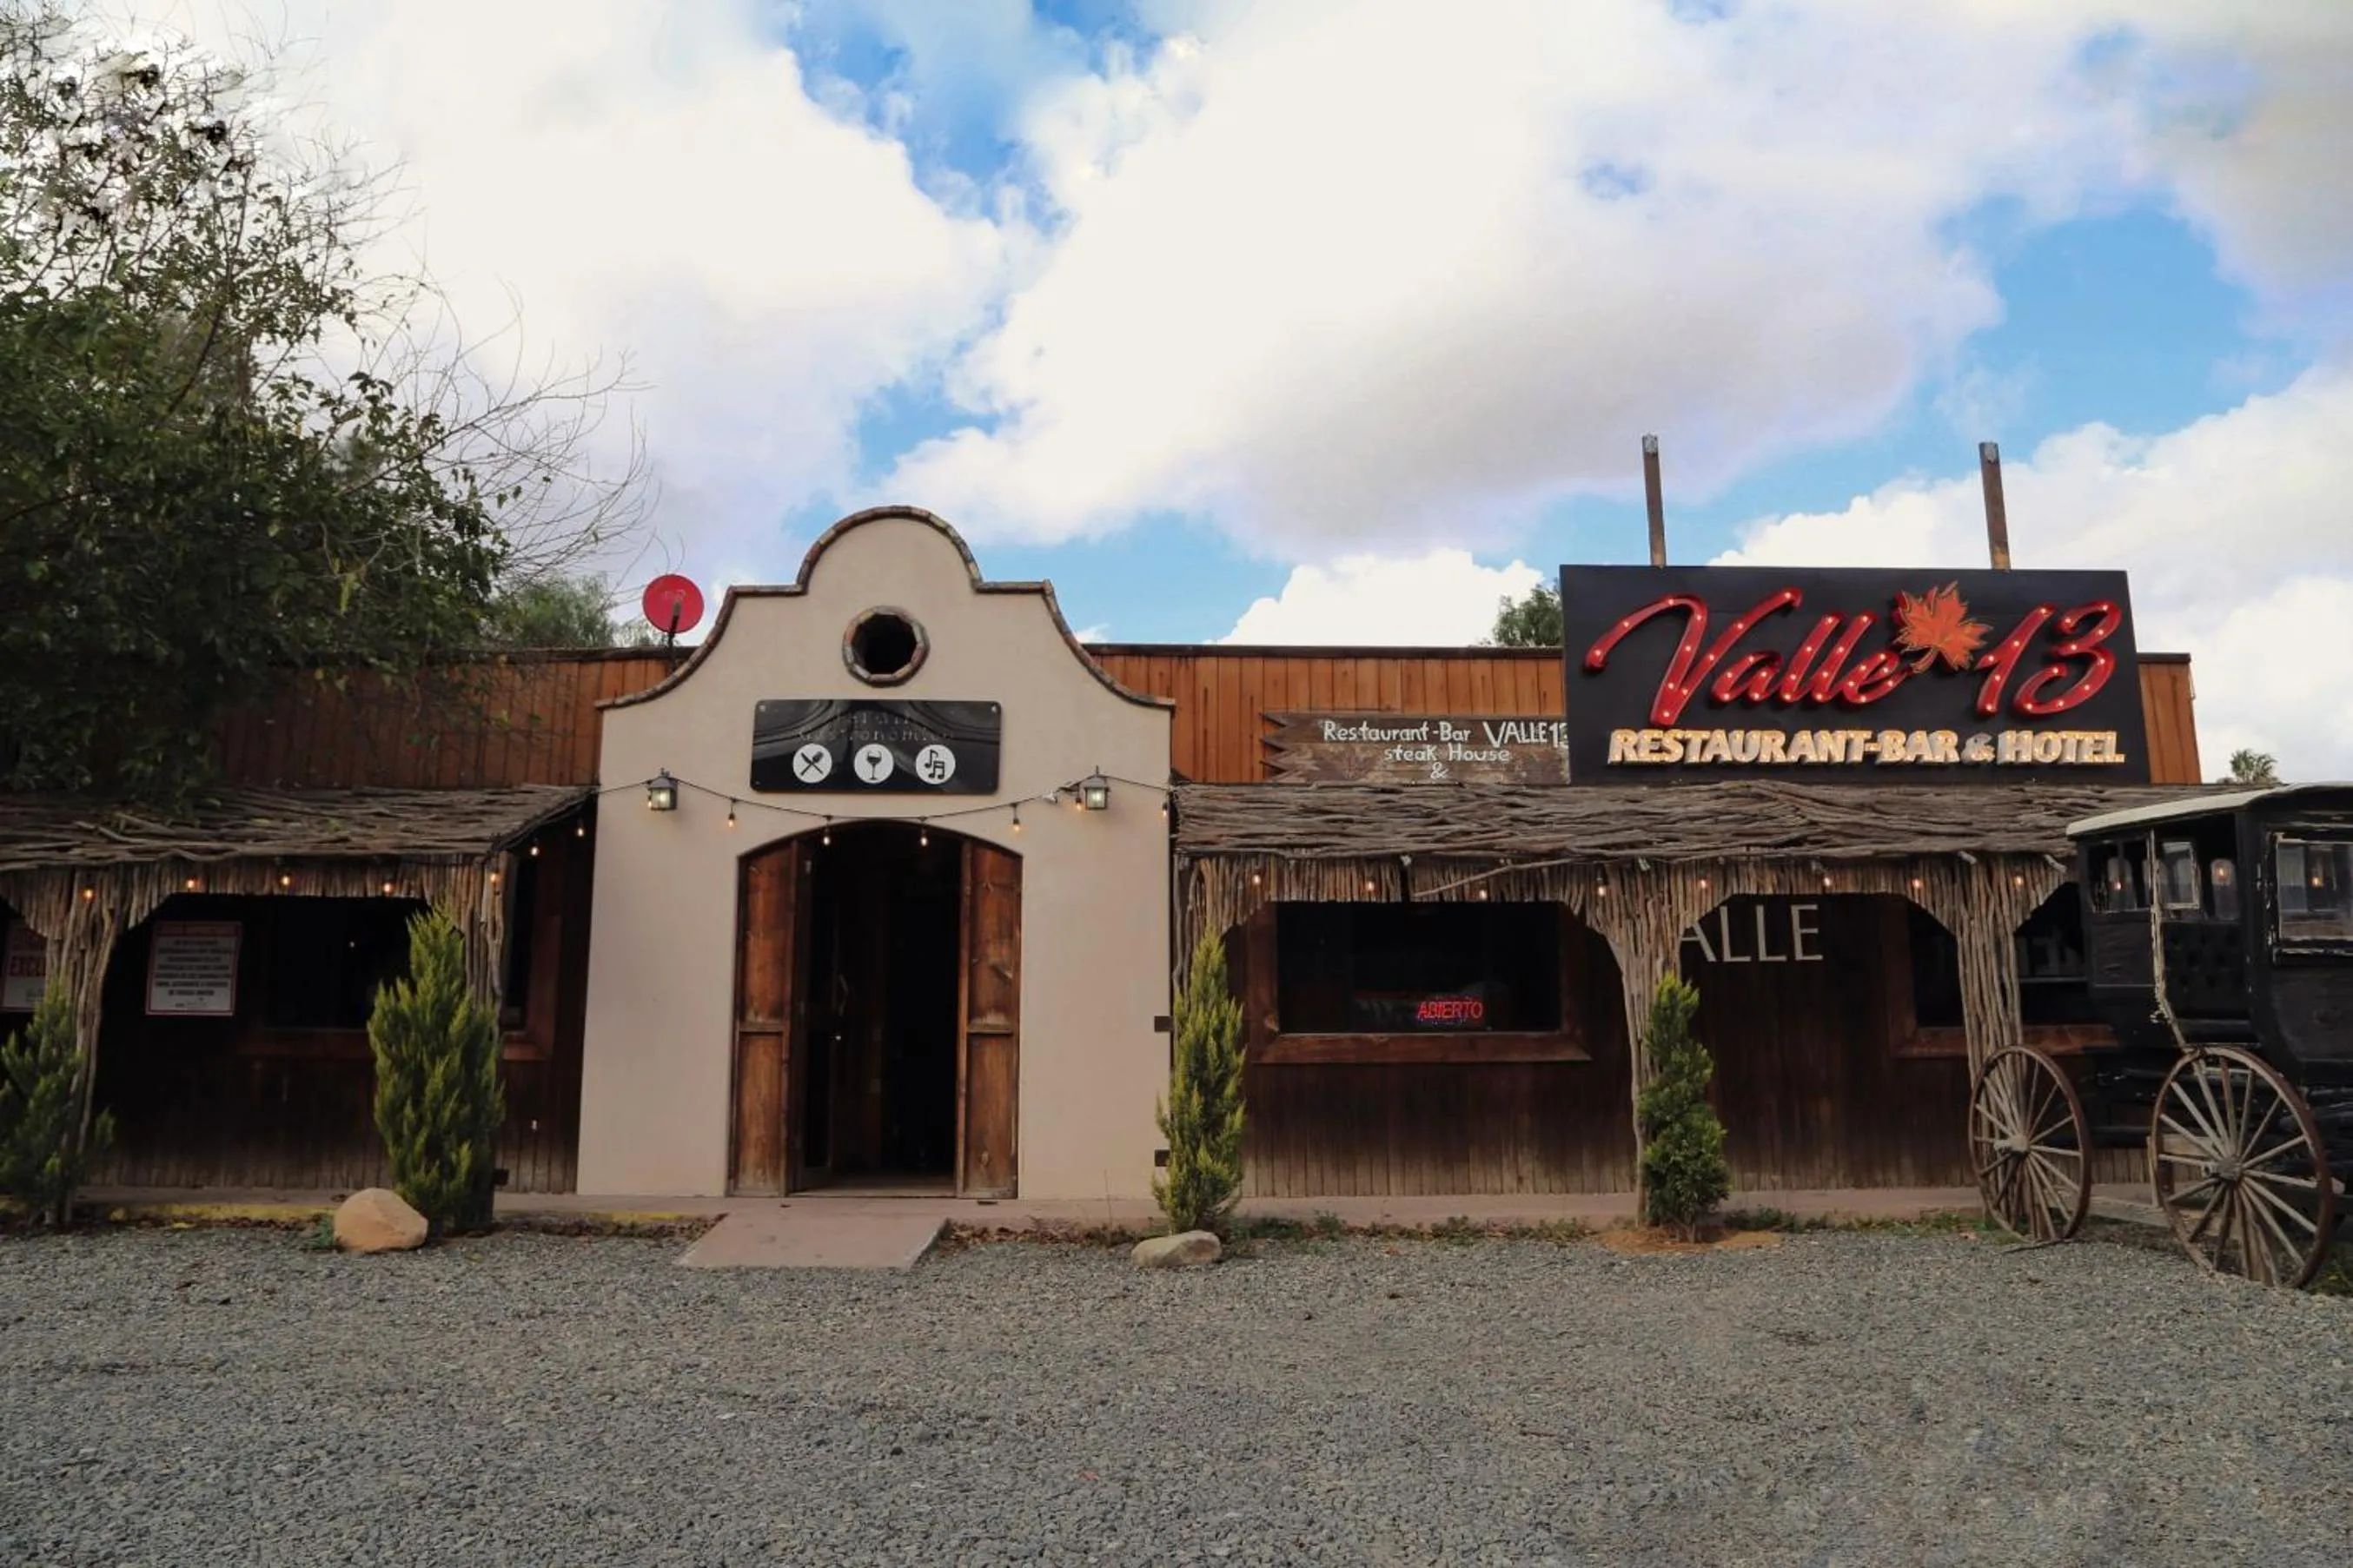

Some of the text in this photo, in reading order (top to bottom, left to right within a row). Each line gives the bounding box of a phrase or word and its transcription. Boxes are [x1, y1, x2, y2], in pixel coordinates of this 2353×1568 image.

[1583, 586, 2124, 726] Valle 13
[1448, 744, 1512, 762] House
[1607, 728, 2126, 766] RESTAURANT-BAR & HOTEL
[1429, 762, 1448, 779] &
[1680, 904, 1825, 963] ALLE
[1417, 999, 1484, 1019] ABIERTO
